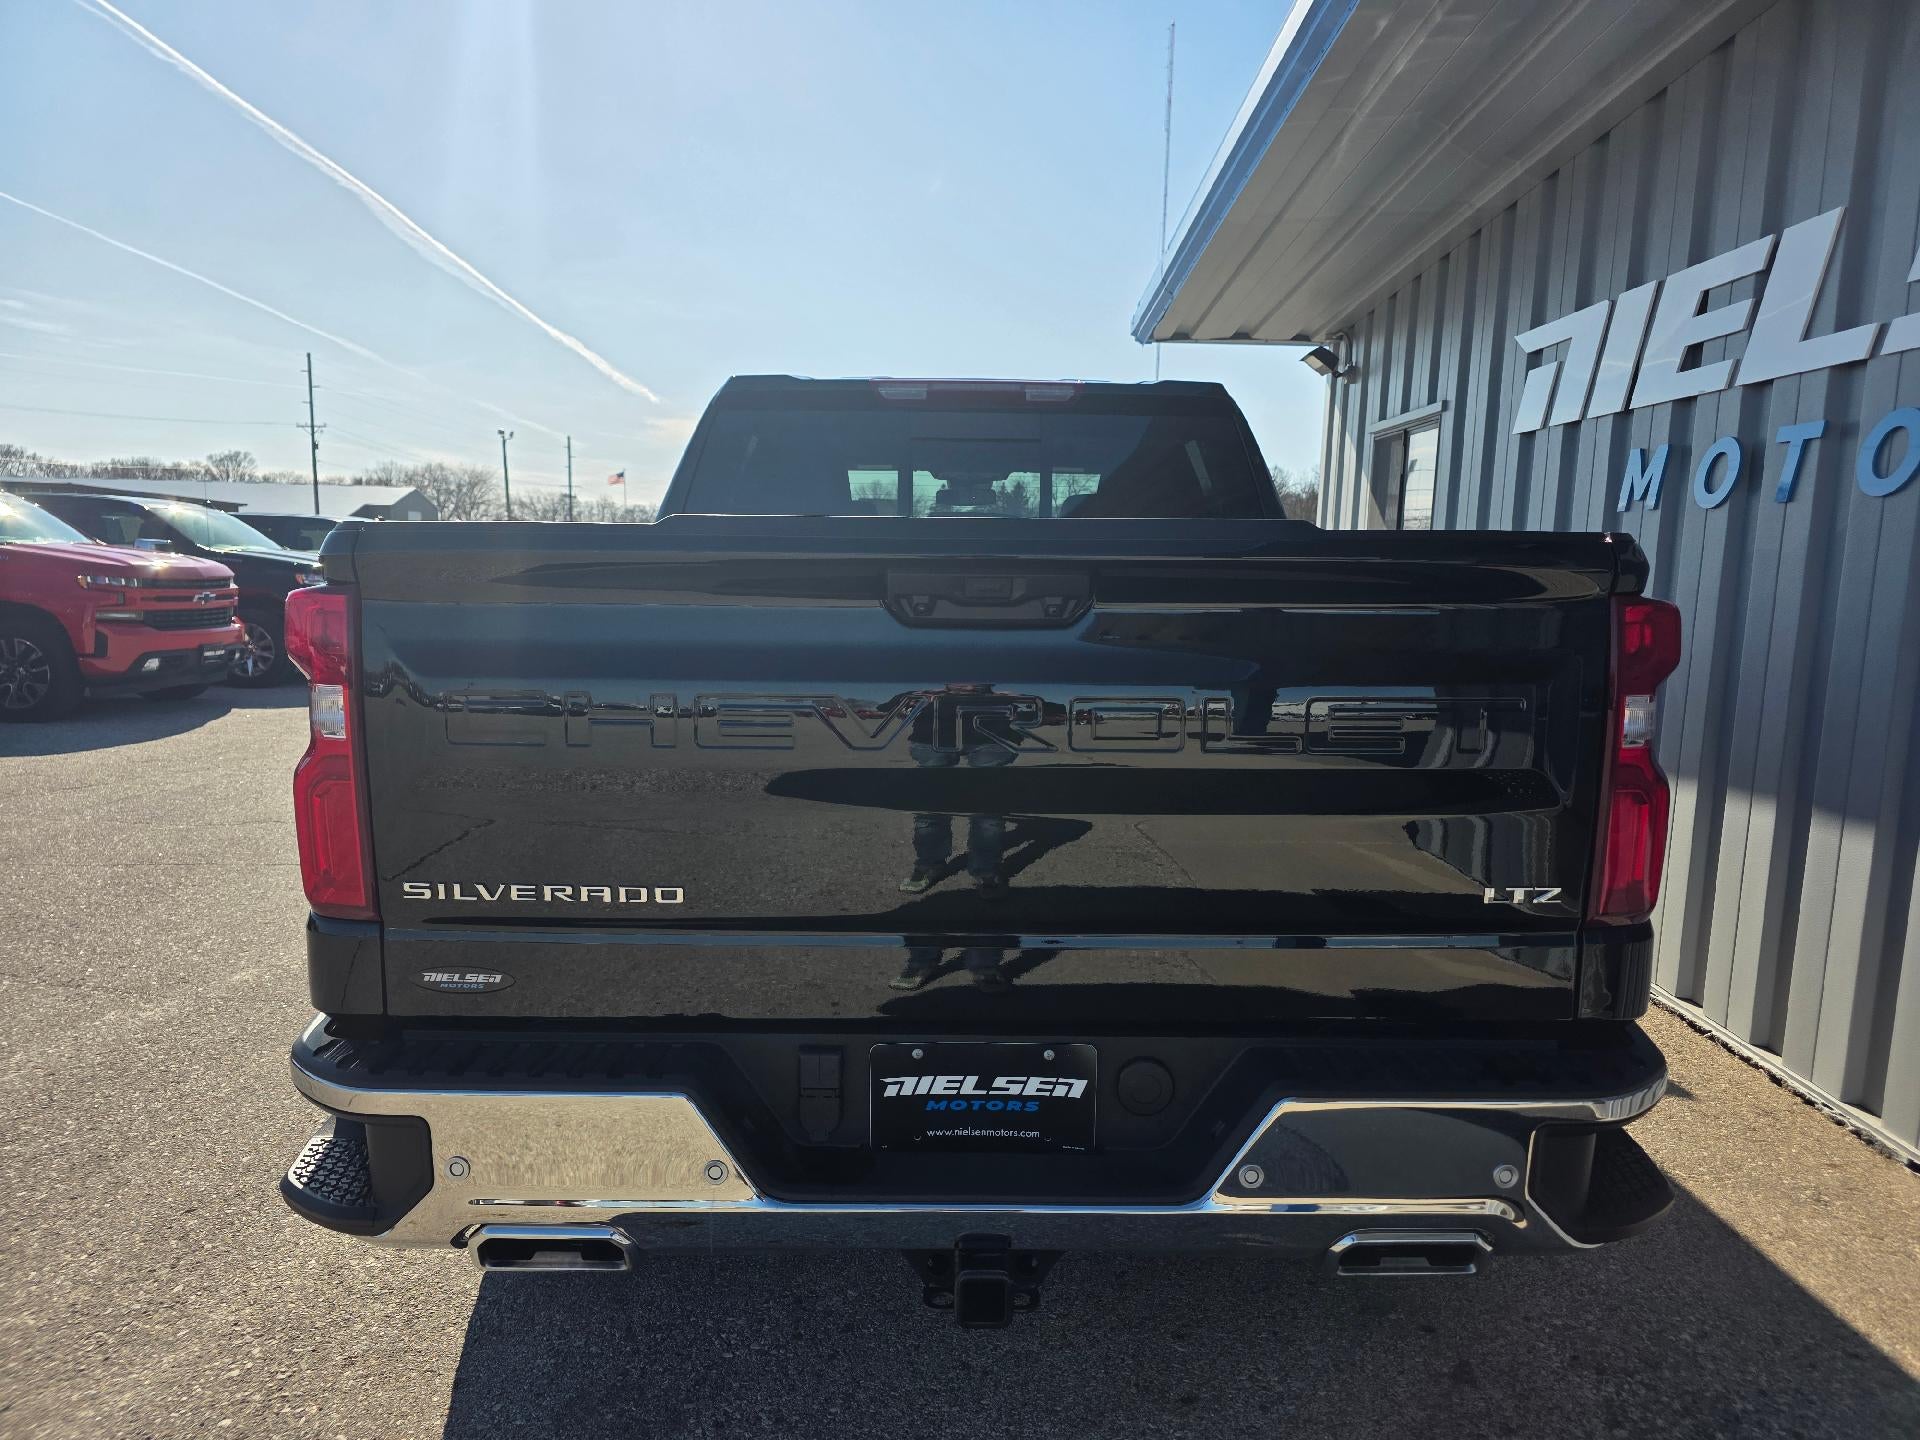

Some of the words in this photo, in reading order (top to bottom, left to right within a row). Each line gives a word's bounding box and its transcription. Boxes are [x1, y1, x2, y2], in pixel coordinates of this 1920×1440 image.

[444, 689, 1527, 754] CHEVROLET
[402, 882, 684, 904] SILVERADO
[1483, 887, 1562, 904] LTZ
[422, 972, 503, 983] NIELSEN
[880, 1075, 1088, 1098] NIELSEN
[925, 1100, 1039, 1112] MOTORS
[926, 1126, 1040, 1138] www.nielsenmotors.com
